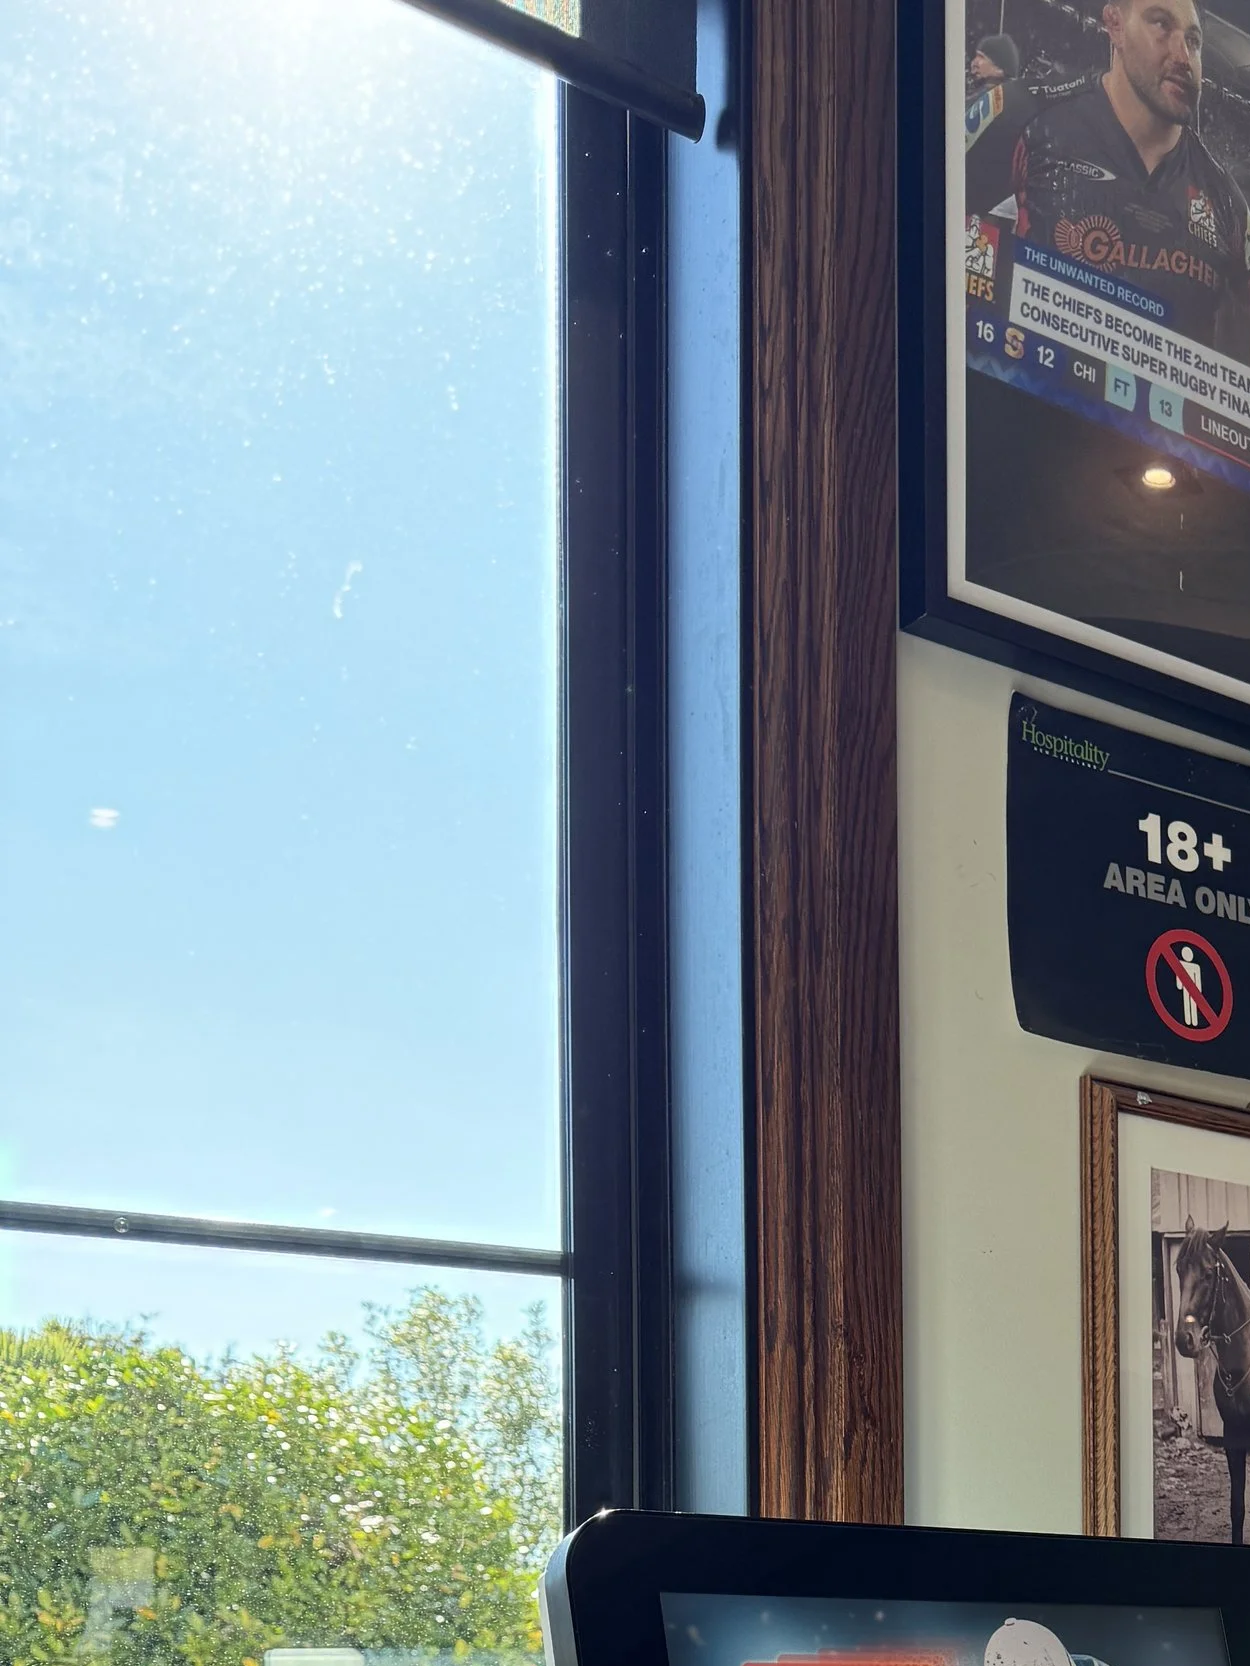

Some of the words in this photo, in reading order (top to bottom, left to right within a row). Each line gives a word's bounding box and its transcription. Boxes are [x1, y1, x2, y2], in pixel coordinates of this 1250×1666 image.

[1025, 246, 1047, 267] THE
[1050, 255, 1114, 296] UNWANTED
[1118, 287, 1164, 317] RECORD
[1020, 302, 1119, 356] CONSECUTIVE
[1122, 346, 1167, 377] SUPER
[1171, 367, 1216, 401] RUGBY
[1023, 278, 1049, 300] THE
[1053, 291, 1102, 324] CHIEFS
[1105, 314, 1162, 350] BECOME
[1165, 339, 1192, 365] THE
[1194, 356, 1217, 377] 2nd
[976, 320, 994, 342] 16
[1038, 345, 1055, 368] 12
[1073, 361, 1096, 383] CHI
[1114, 377, 1129, 397] FT
[1159, 400, 1173, 417] 13
[1022, 720, 1110, 771] Hospitality
[1138, 813, 1232, 872] 18+
[1104, 863, 1187, 908] AREA
